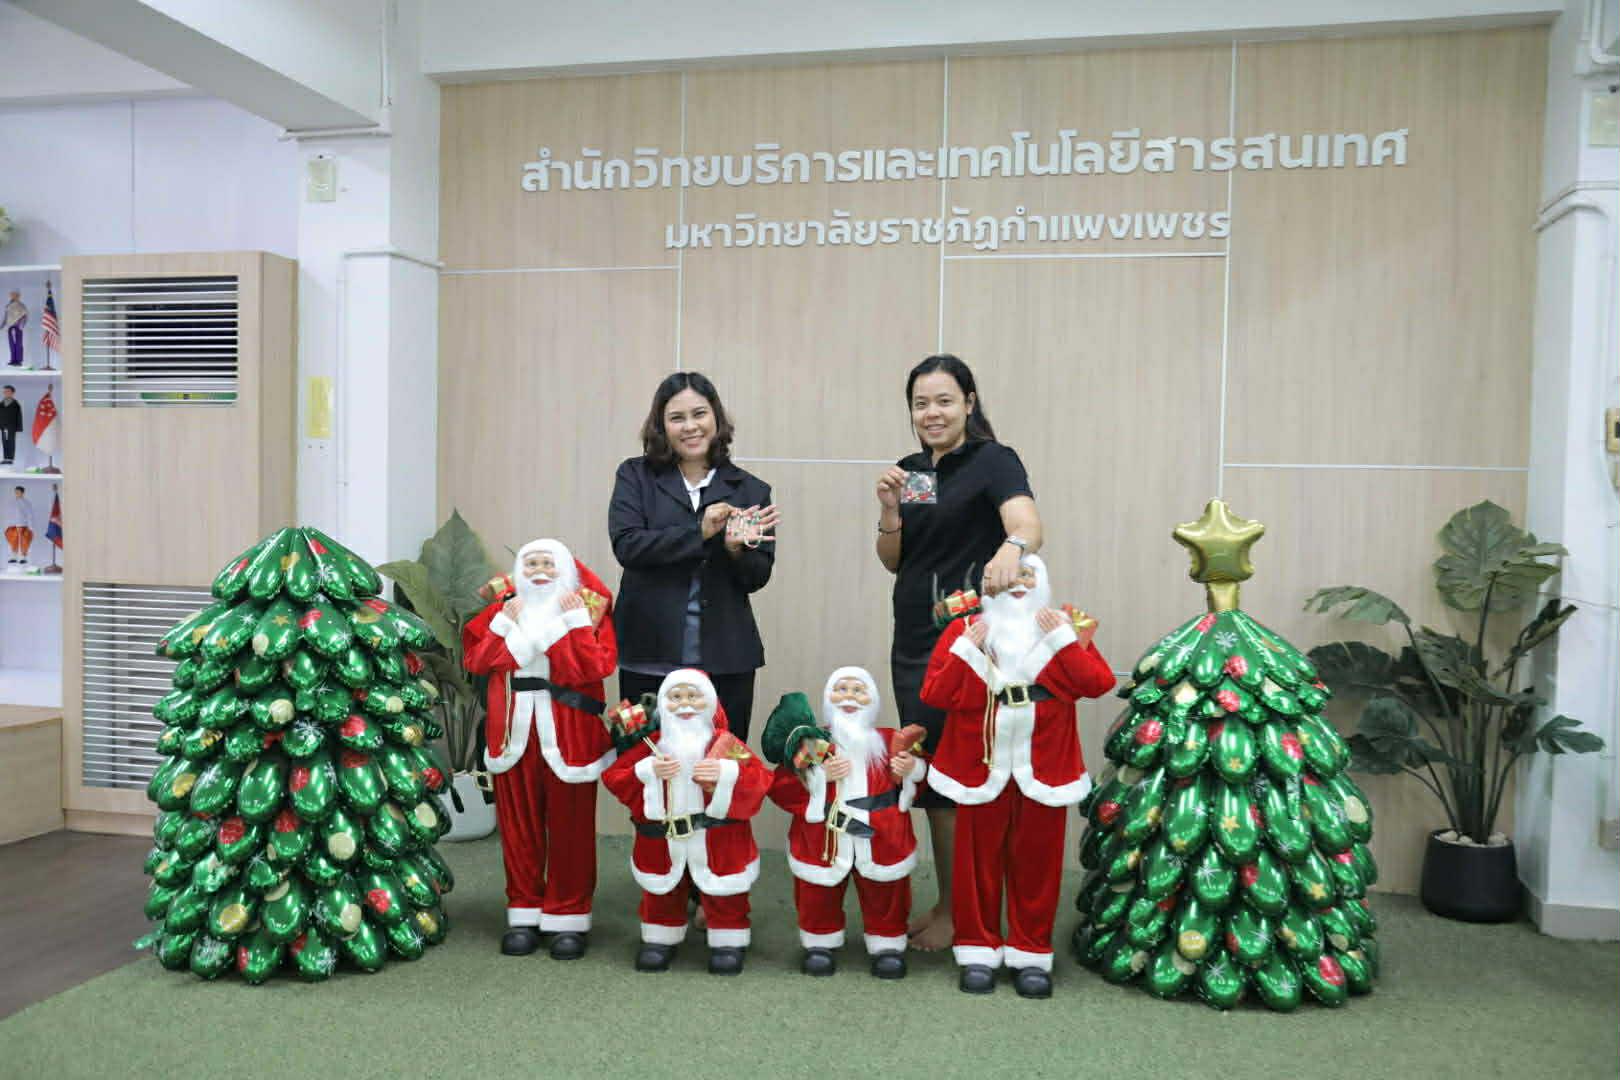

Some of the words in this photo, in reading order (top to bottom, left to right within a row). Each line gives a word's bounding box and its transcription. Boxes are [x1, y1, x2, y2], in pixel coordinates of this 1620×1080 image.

[521, 127, 1409, 192] สำนักวิทยบริการและเทคโนโลยีสารสนเทศ
[665, 206, 1231, 250] มหาวิทยาลัยราชภัฏกำแพงเพชร
